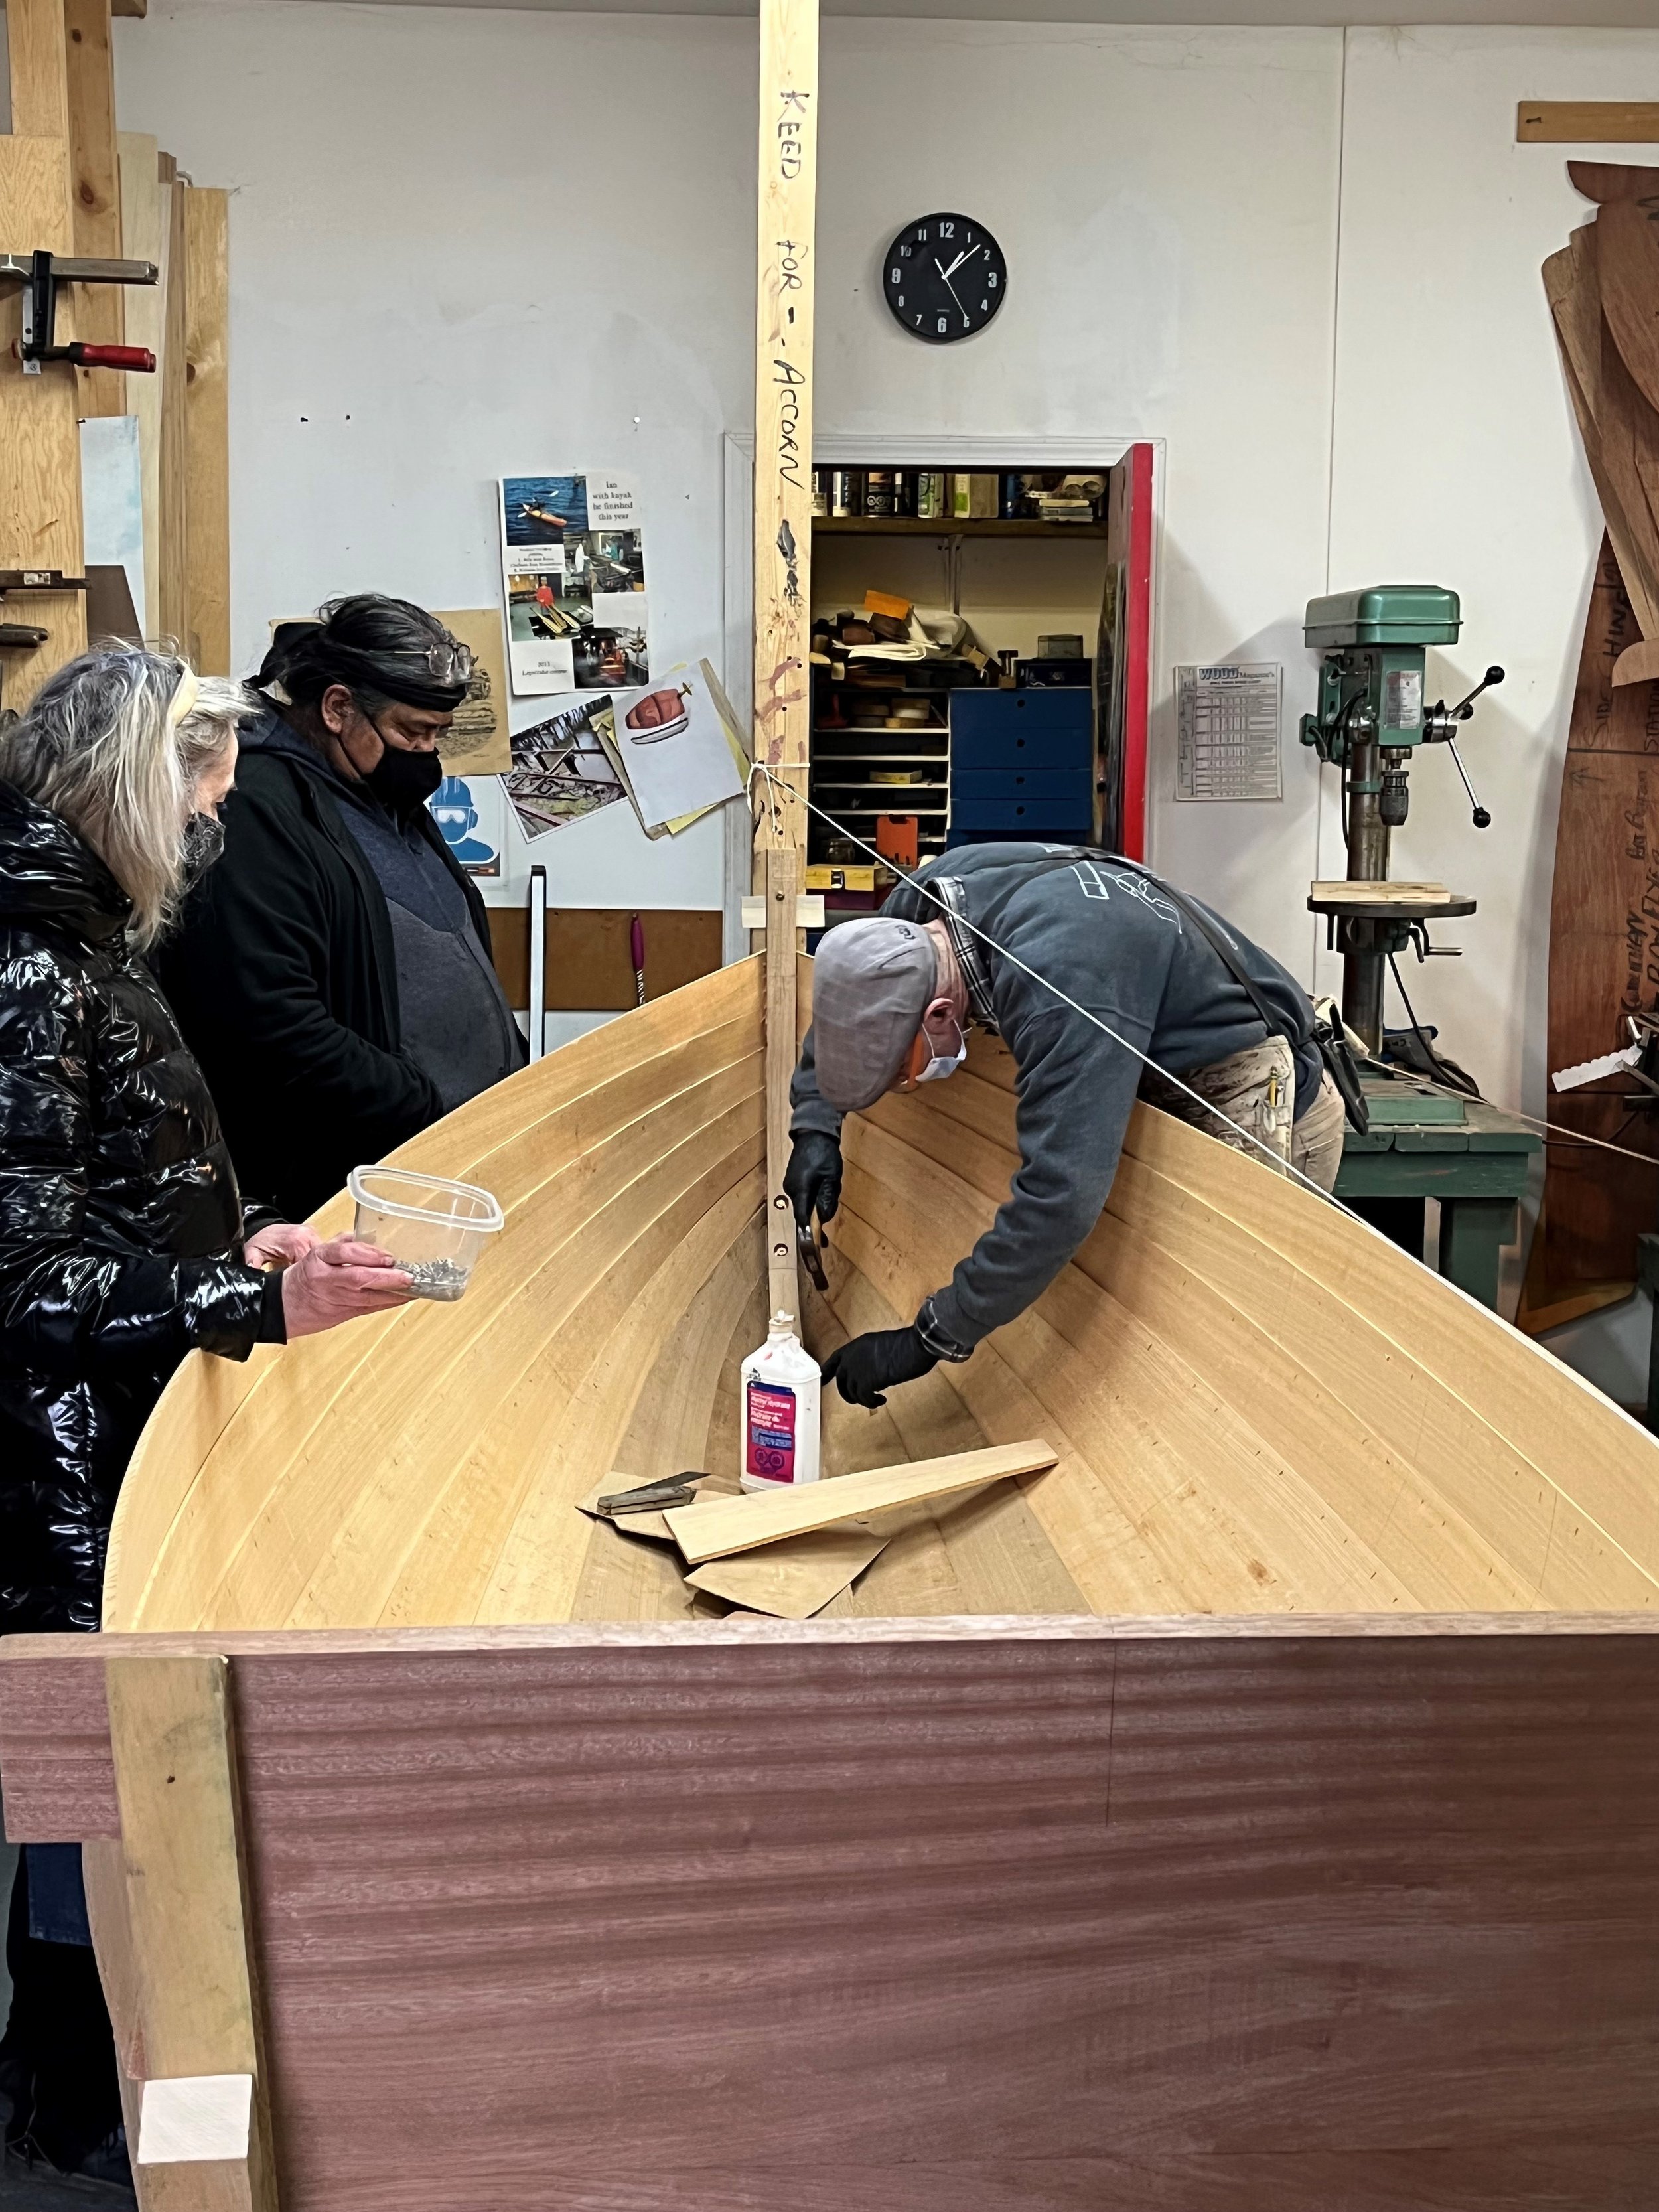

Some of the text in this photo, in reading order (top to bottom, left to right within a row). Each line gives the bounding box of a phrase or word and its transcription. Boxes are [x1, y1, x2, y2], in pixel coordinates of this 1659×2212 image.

[918, 229, 927, 241] 11
[939, 222, 955, 238] 12
[968, 232, 971, 243] 1
[901, 245, 912, 258] 10
[983, 250, 990, 261] 2
[891, 268, 901, 283] 9
[988, 272, 997, 288] 3
[898, 295, 904, 307] 8
[981, 299, 988, 311] 4
[916, 314, 922, 325] 7
[938, 317, 947, 332] 6
[773, 360, 805, 490] ACCORN
